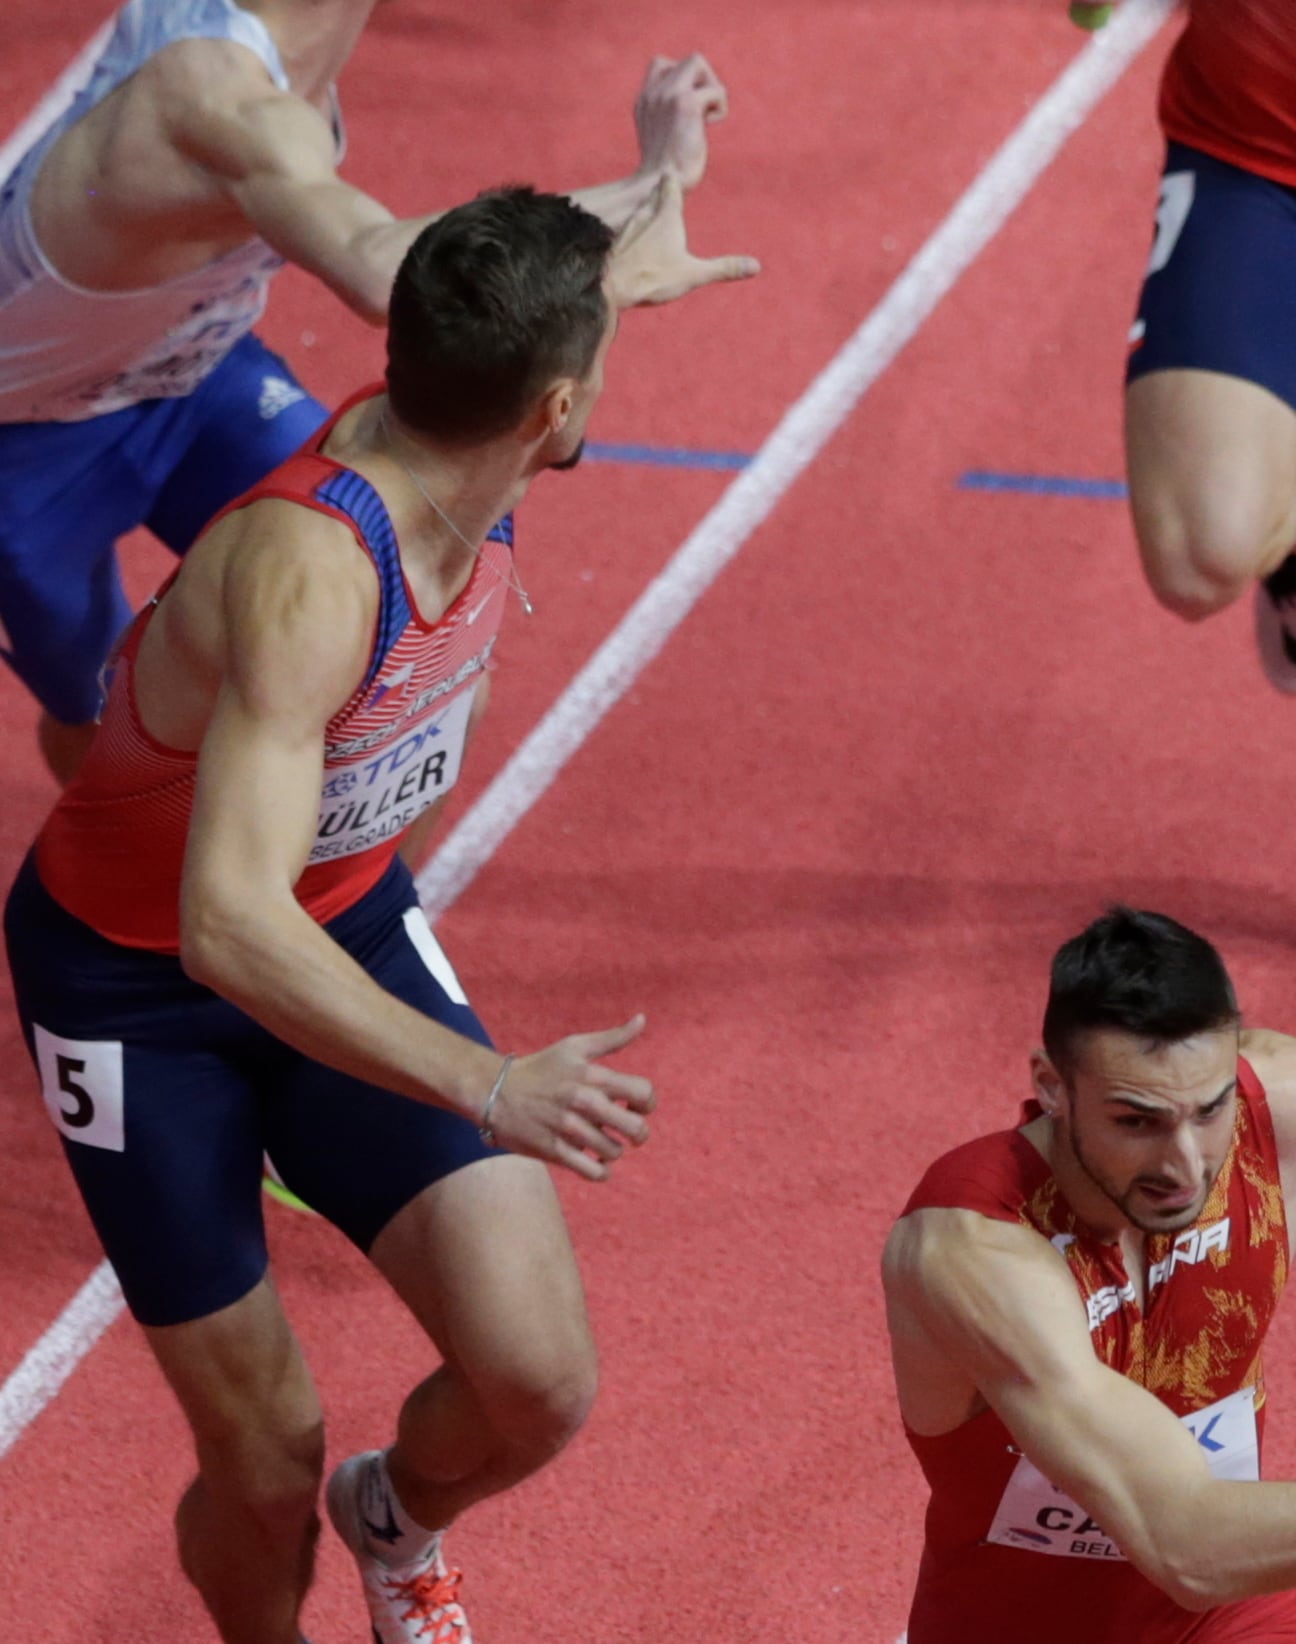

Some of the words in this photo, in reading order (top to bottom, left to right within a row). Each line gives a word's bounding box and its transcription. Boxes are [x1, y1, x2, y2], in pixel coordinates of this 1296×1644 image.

[362, 706, 450, 786] TDK
[317, 750, 447, 838] ÜLLER
[56, 1053, 95, 1129] 5
